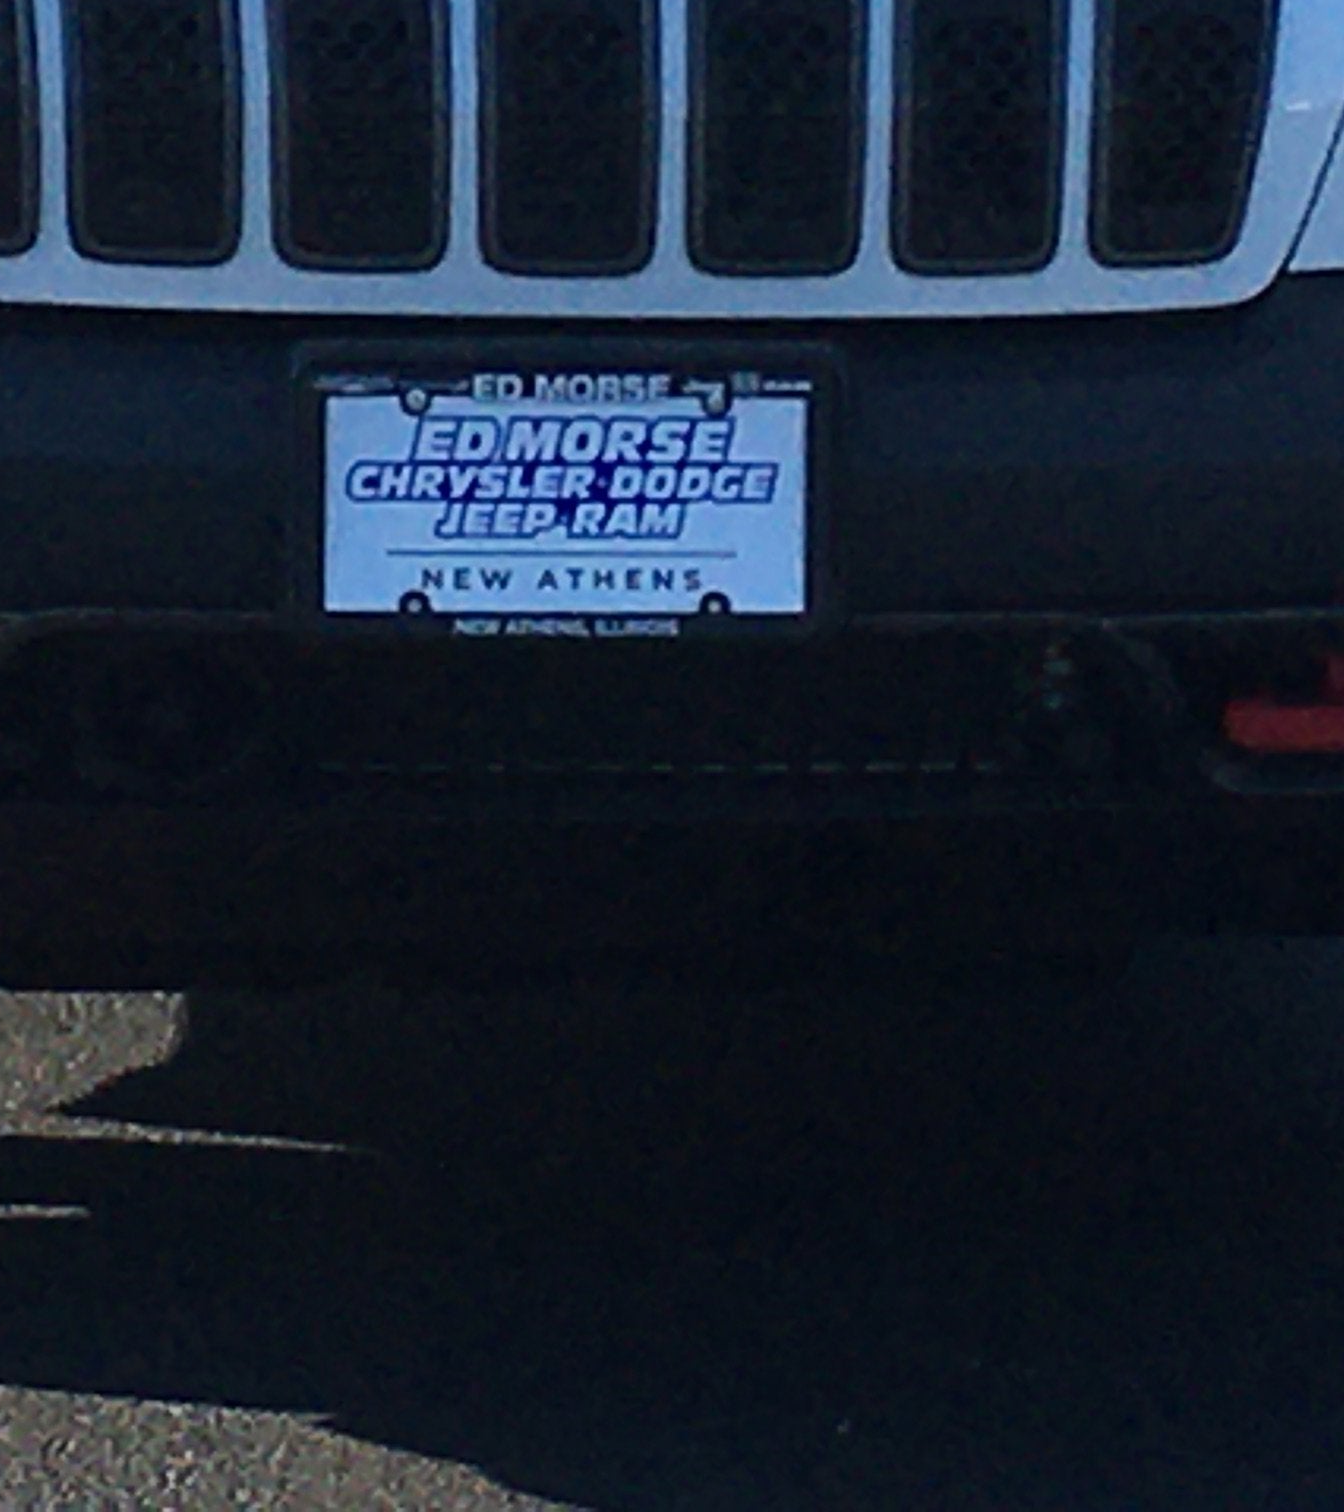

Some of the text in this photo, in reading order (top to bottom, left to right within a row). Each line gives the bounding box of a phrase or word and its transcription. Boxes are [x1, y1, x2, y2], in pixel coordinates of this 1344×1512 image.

[472, 373, 670, 402] ED MORSE
[412, 418, 732, 462] ED MORSE
[352, 465, 775, 501] CHRYSLER DODGE
[439, 501, 682, 535] JEEP RAM
[421, 567, 702, 590] NEW ATHENS
